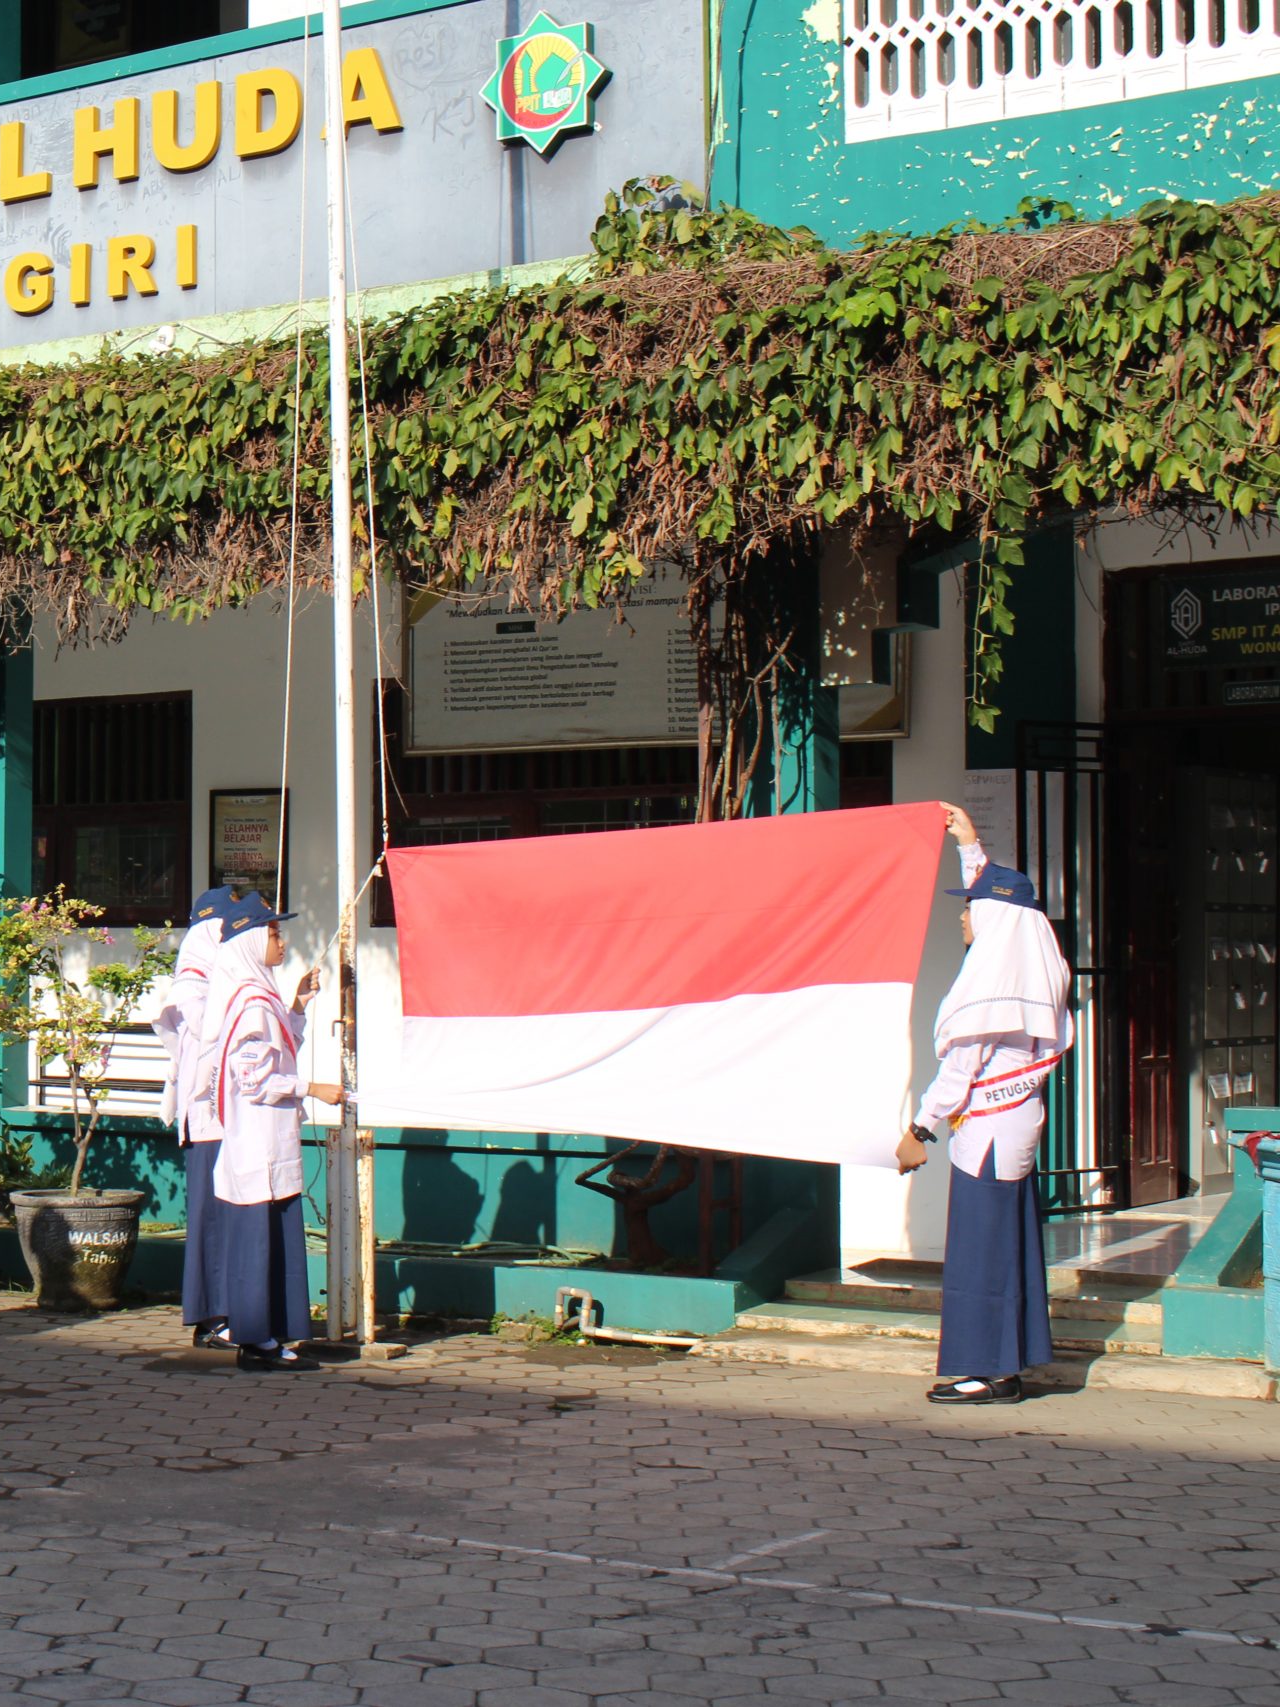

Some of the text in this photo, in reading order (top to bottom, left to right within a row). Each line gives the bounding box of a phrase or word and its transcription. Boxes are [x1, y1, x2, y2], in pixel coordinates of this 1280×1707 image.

[73, 47, 404, 193] HUDA
[1265, 603, 1280, 616] IP
[1211, 626, 1248, 641] SMP
[1252, 624, 1266, 638] IT
[224, 824, 269, 833] LELAHNYA
[224, 834, 262, 843] BELAJAR
[985, 1079, 1036, 1102] PETUGAS
[68, 1230, 128, 1246] WALSAN
